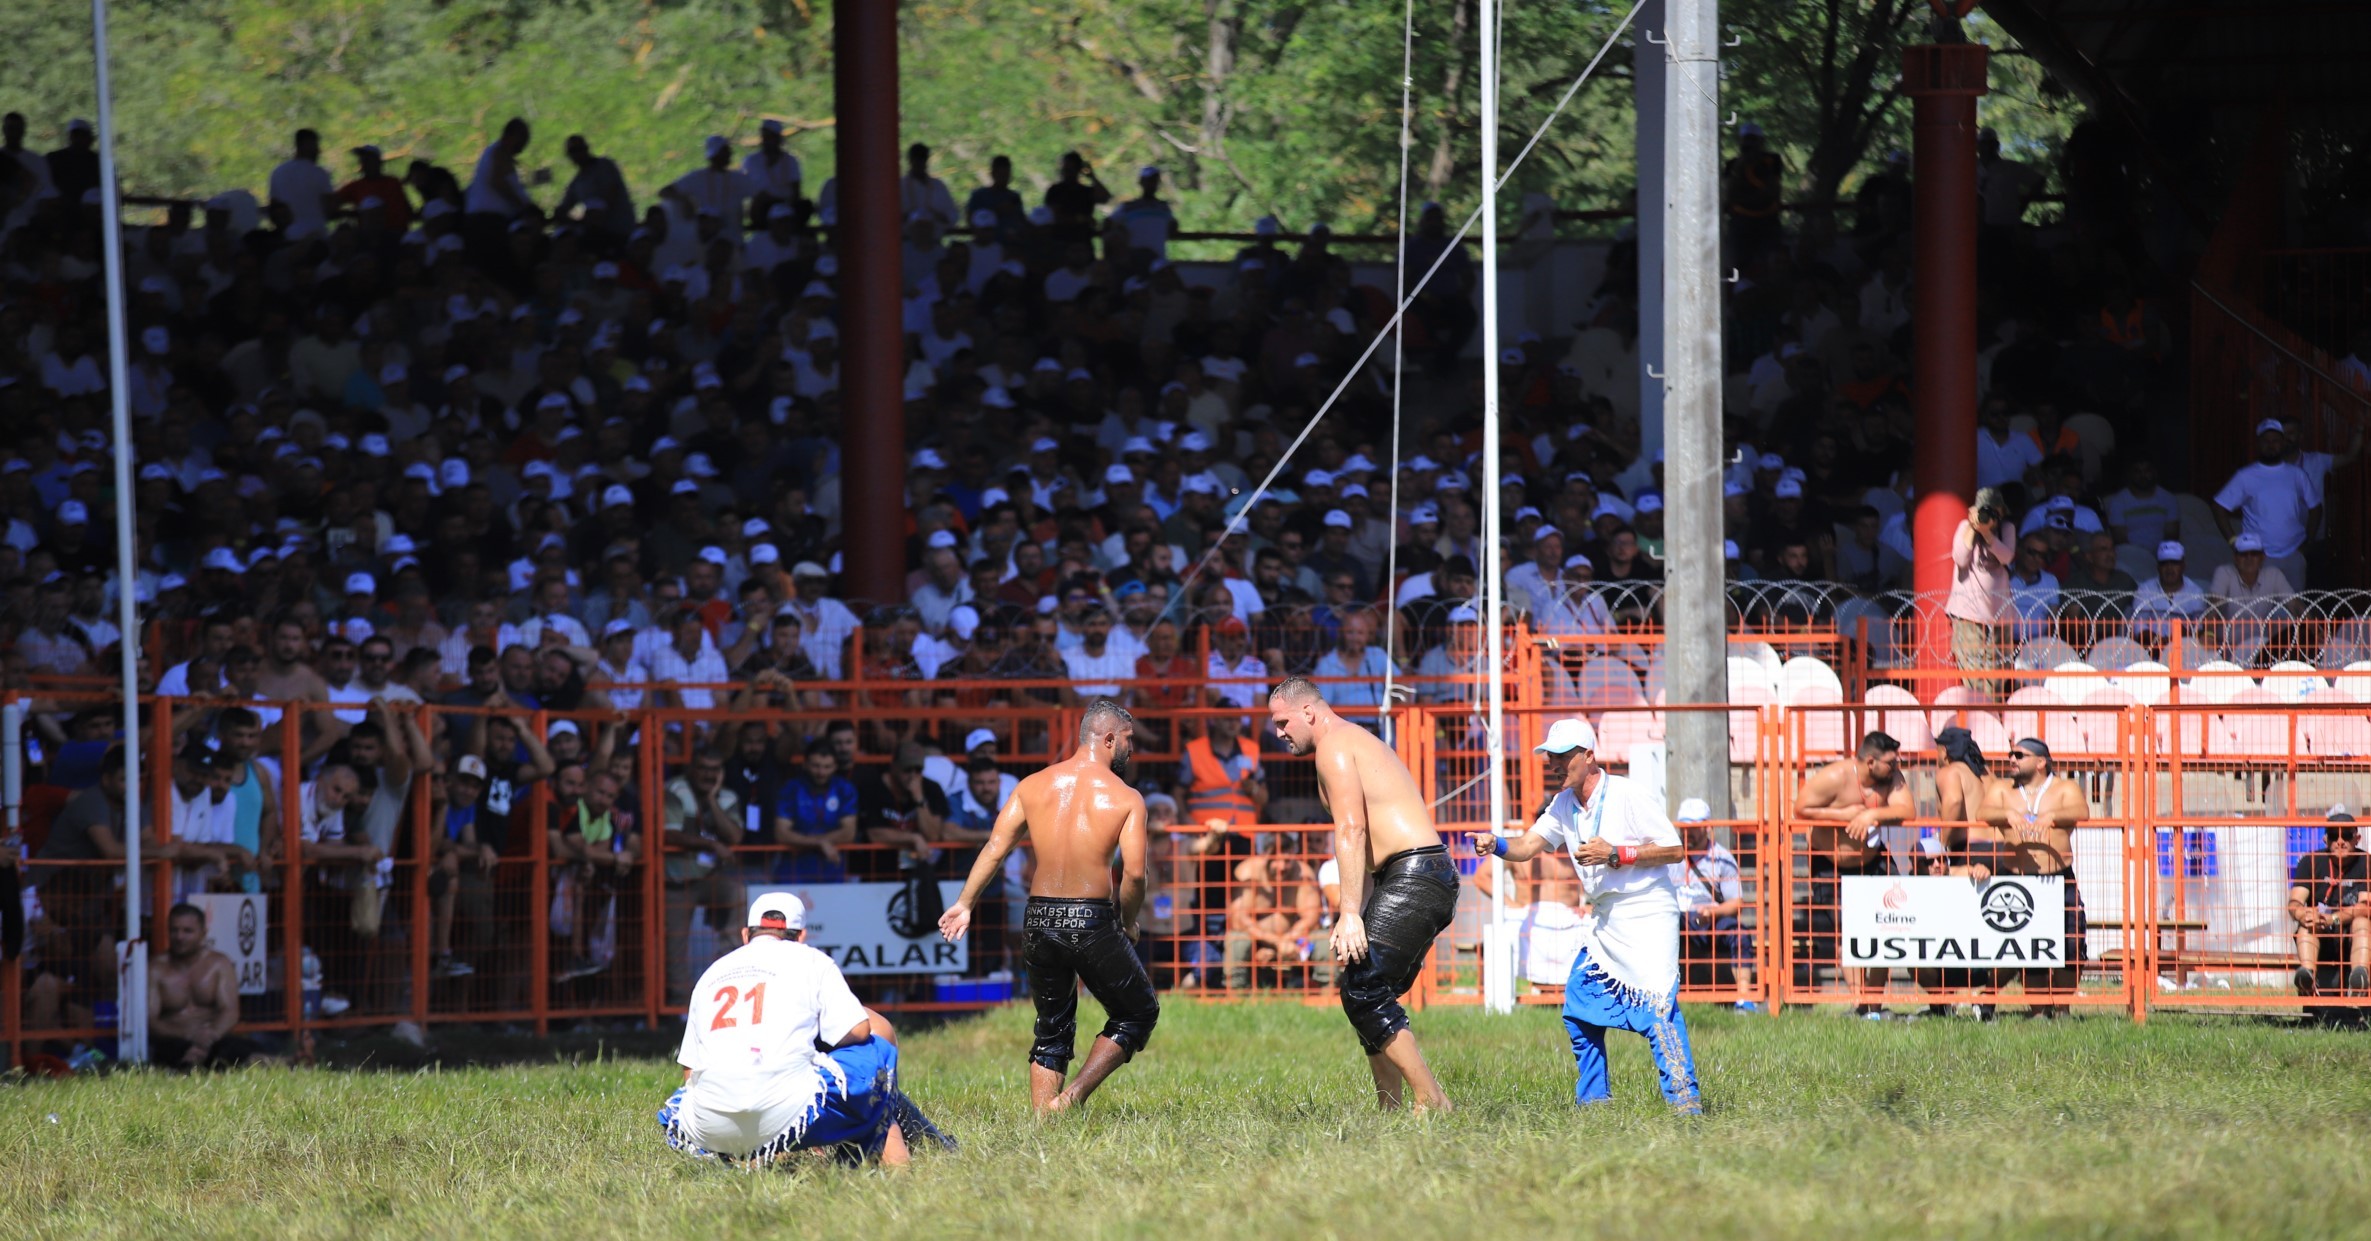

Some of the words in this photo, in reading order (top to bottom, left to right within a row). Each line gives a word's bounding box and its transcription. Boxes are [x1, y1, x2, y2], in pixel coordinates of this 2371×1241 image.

[1054, 919, 1086, 928] SPOR
[1875, 911, 1917, 925] Edirne
[817, 943, 960, 967] TALAR
[1850, 937, 2059, 961] USTALAR
[710, 982, 766, 1032] 21
